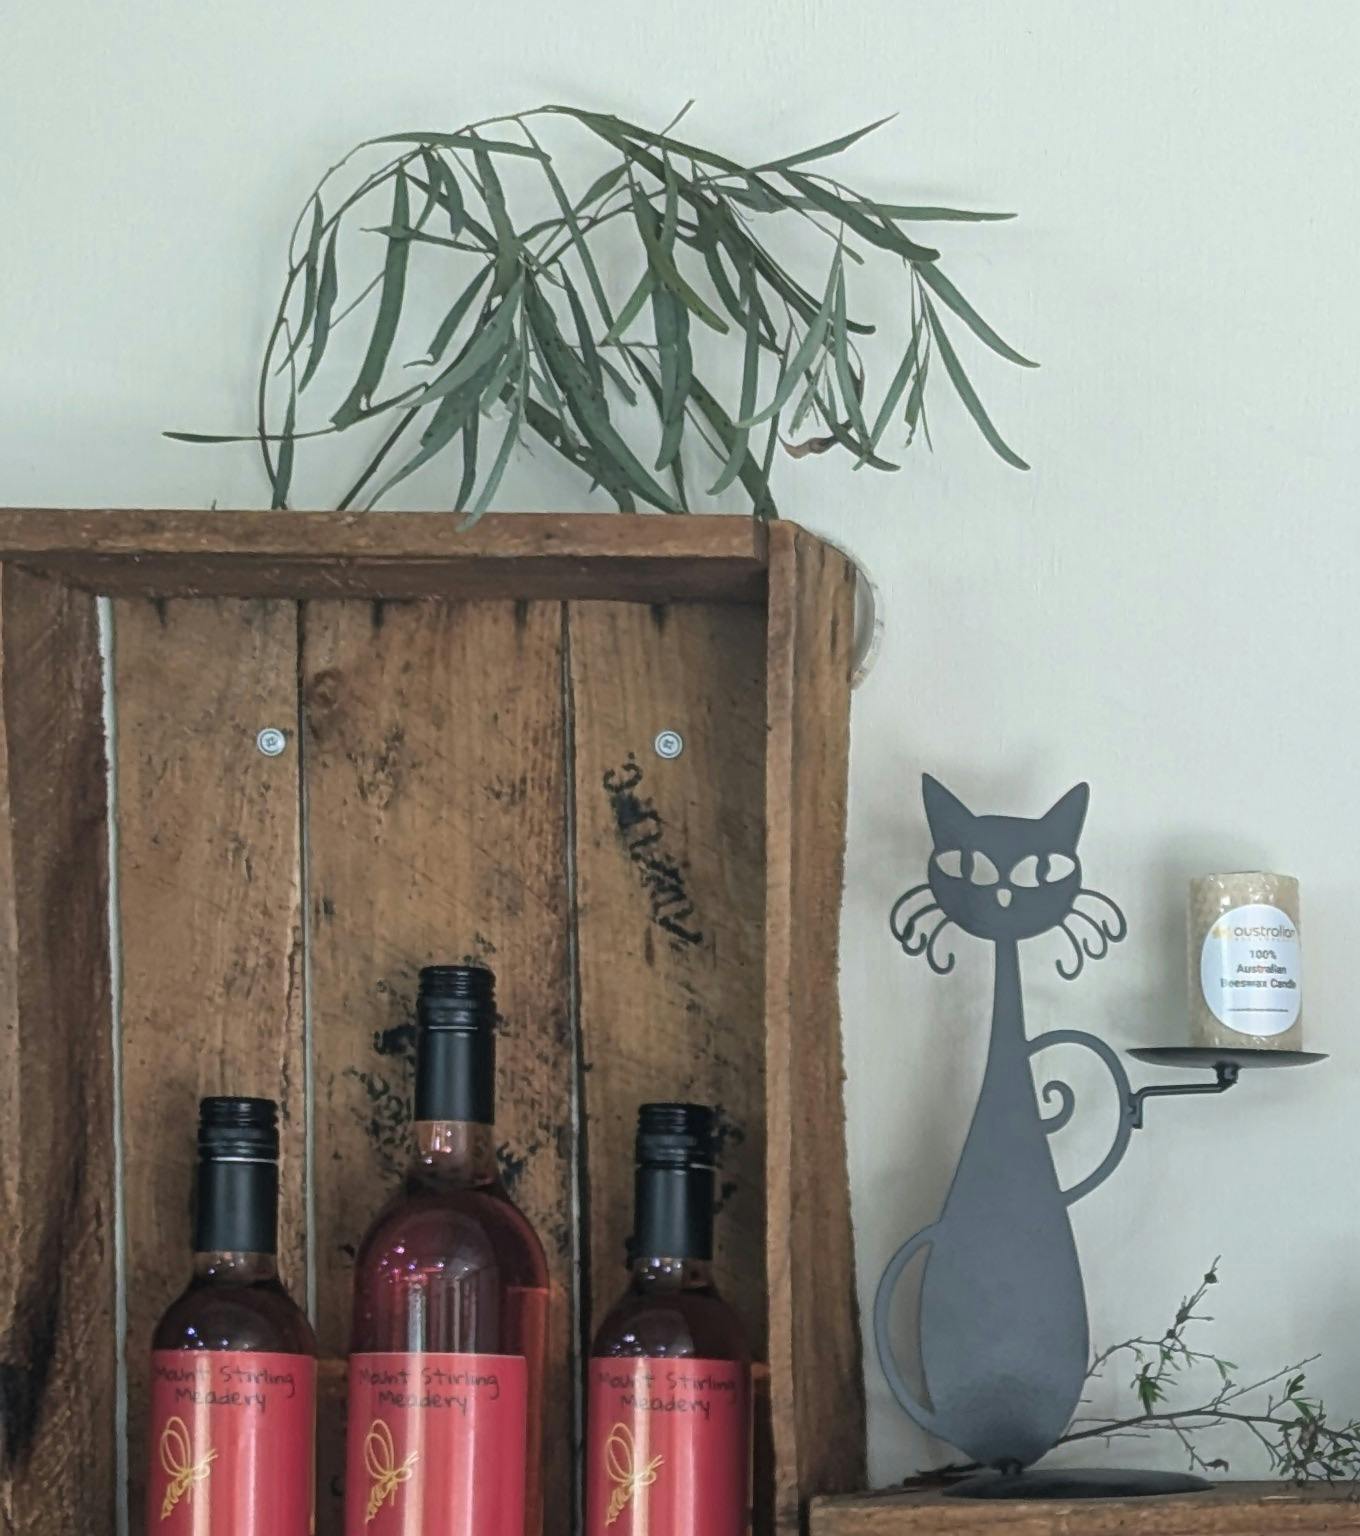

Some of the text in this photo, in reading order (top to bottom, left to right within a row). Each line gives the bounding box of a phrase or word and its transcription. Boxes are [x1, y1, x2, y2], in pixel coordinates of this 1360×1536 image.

[1250, 950, 1276, 959] 100%
[221, 1366, 295, 1397] Stirling
[421, 1367, 500, 1398] Stirling
[176, 1388, 267, 1412] Meadery
[379, 1390, 468, 1415] Meadery
[621, 1395, 711, 1420] Meadery
